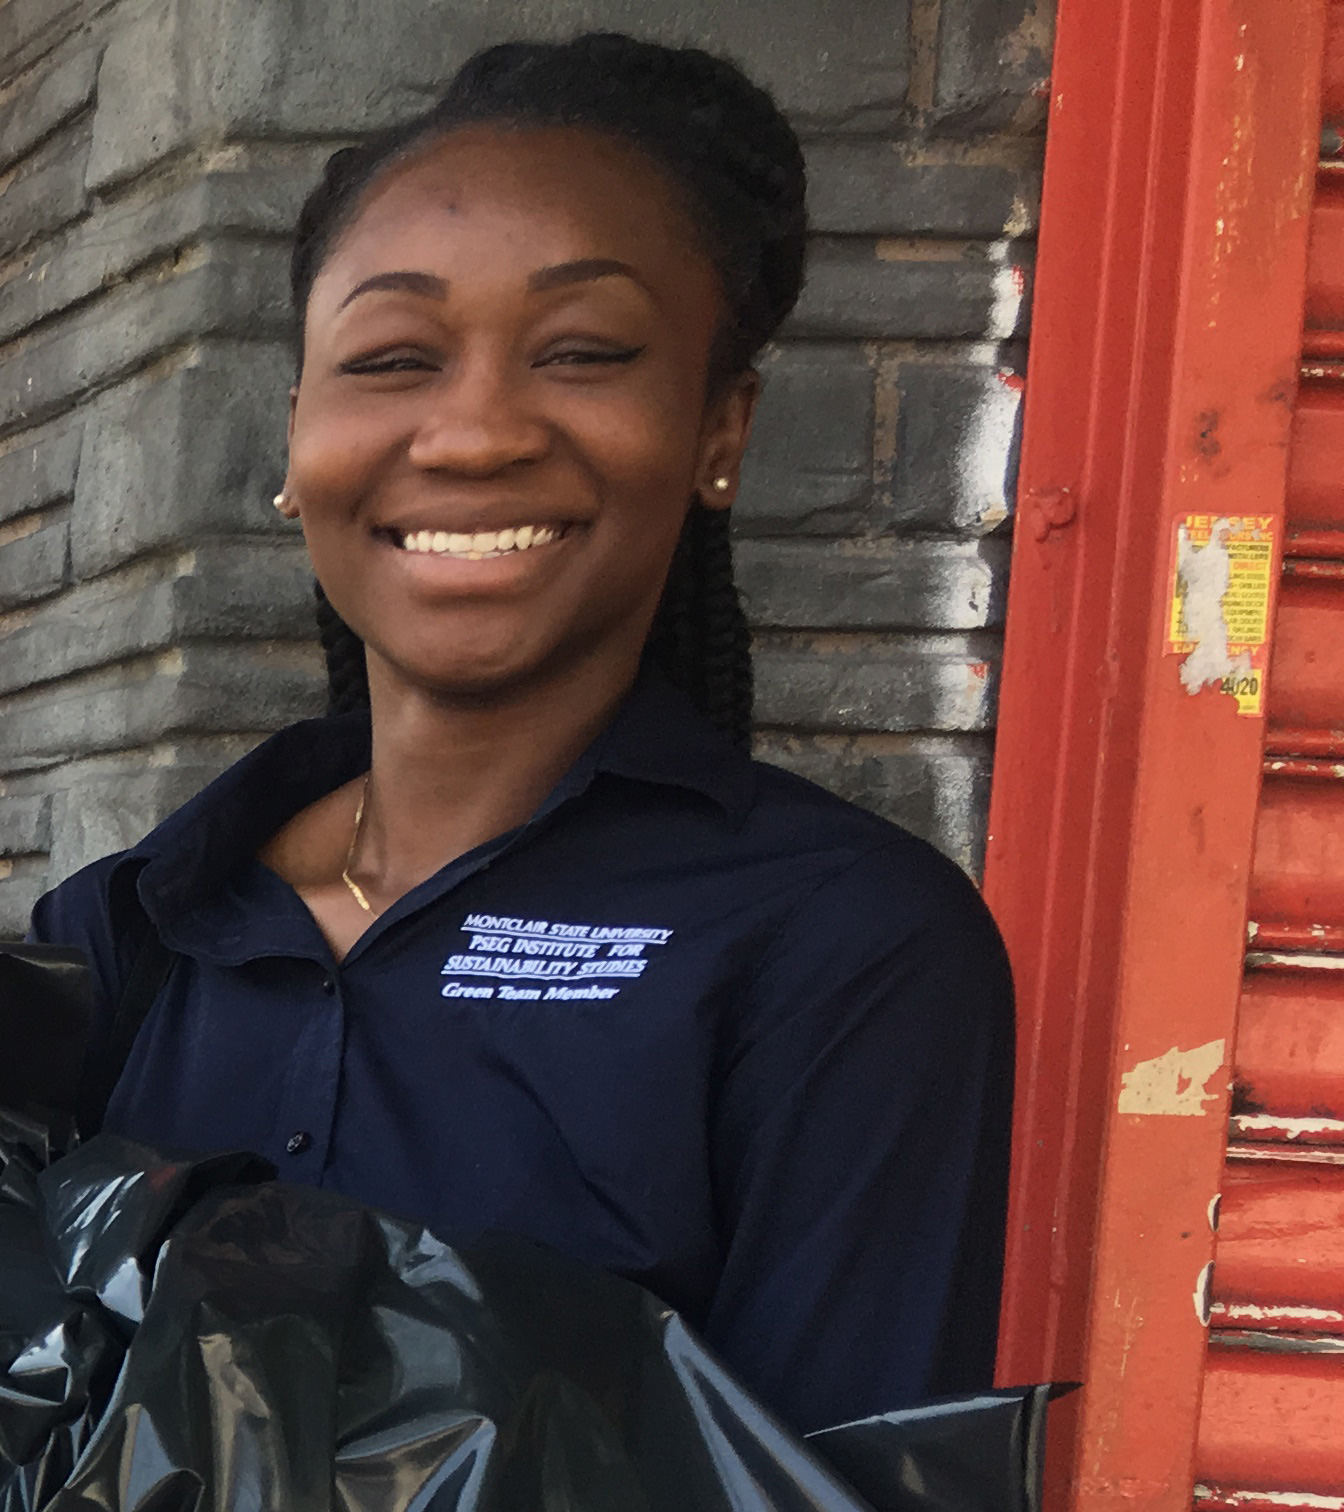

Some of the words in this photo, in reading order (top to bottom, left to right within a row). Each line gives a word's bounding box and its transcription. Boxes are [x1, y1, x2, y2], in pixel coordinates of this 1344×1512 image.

[464, 914, 548, 933] MONTCLAIR
[549, 923, 590, 938] STATE
[590, 927, 674, 940] UNIVERSITY
[469, 935, 512, 953] PSEG
[512, 939, 600, 958] INSTITUTE
[607, 944, 645, 957] FOR
[444, 955, 578, 975] SUSTAINABILITY
[576, 959, 648, 975] STUDIES
[441, 982, 494, 998] Green
[497, 985, 541, 1000] Team
[542, 985, 620, 1000] Member
